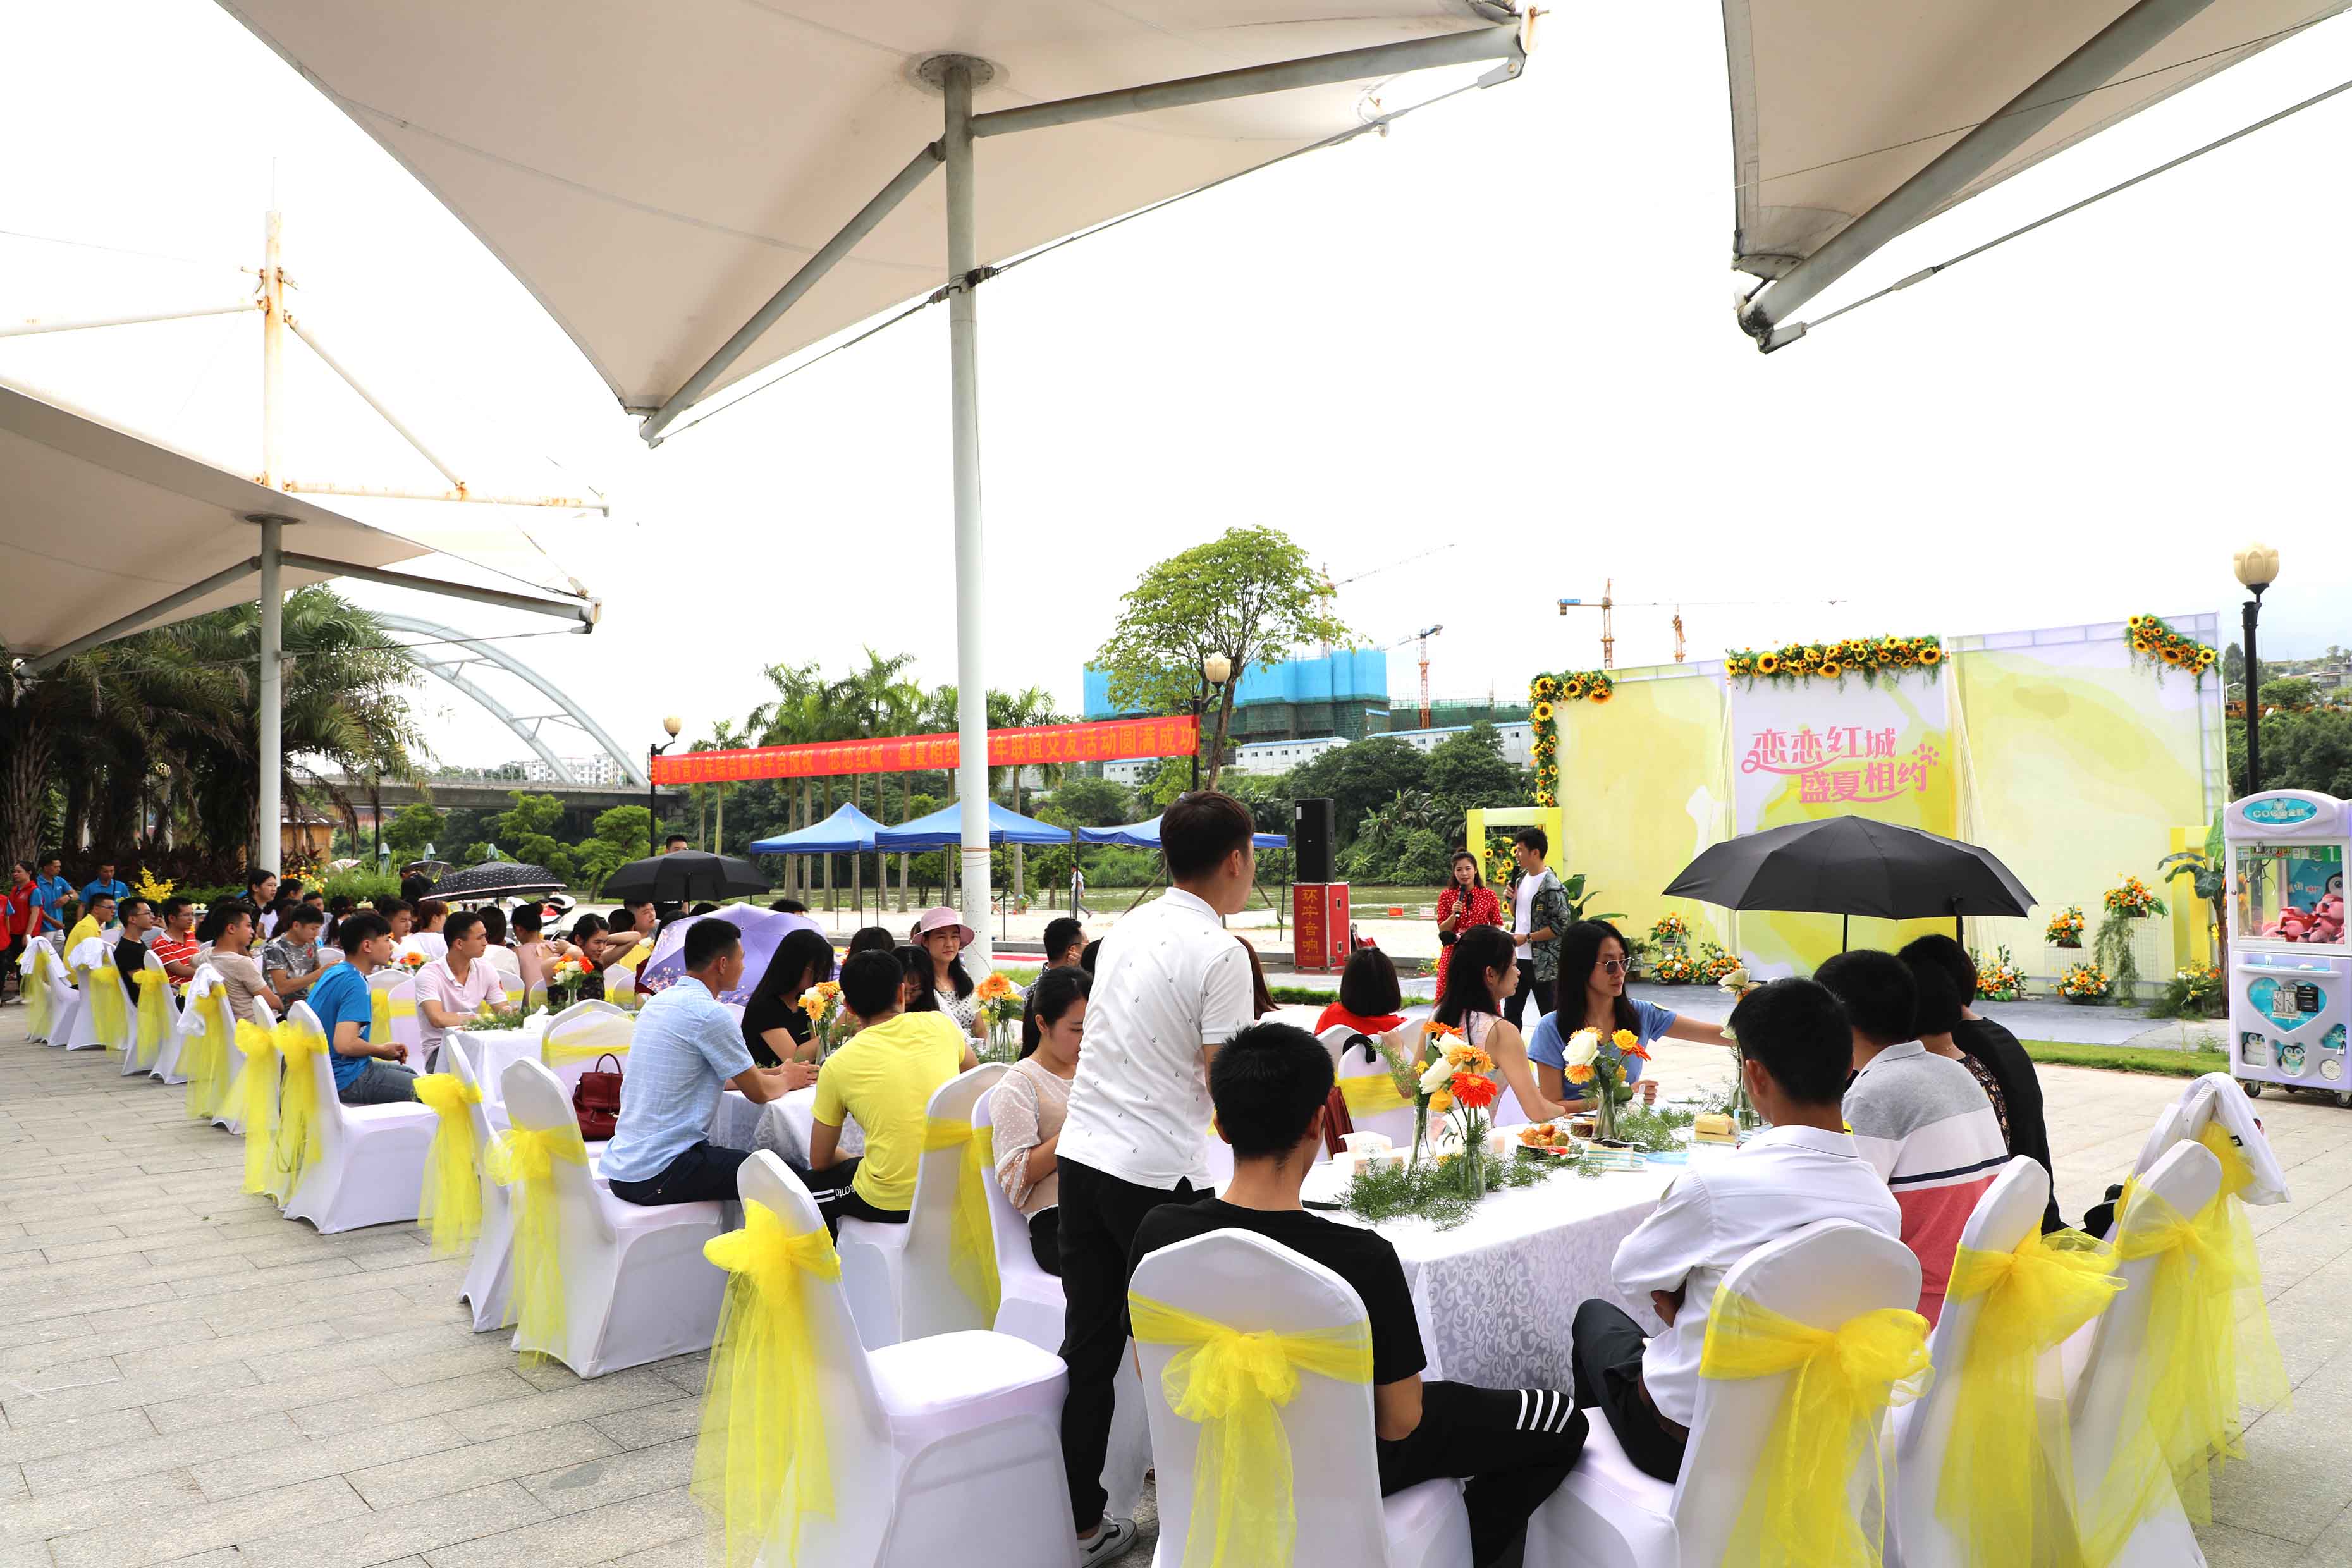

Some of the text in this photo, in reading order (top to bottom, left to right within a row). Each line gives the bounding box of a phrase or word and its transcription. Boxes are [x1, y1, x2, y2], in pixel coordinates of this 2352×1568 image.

[1742, 726, 1896, 773] 恋恋红城
[1800, 762, 1927, 804] 盛夏相约
